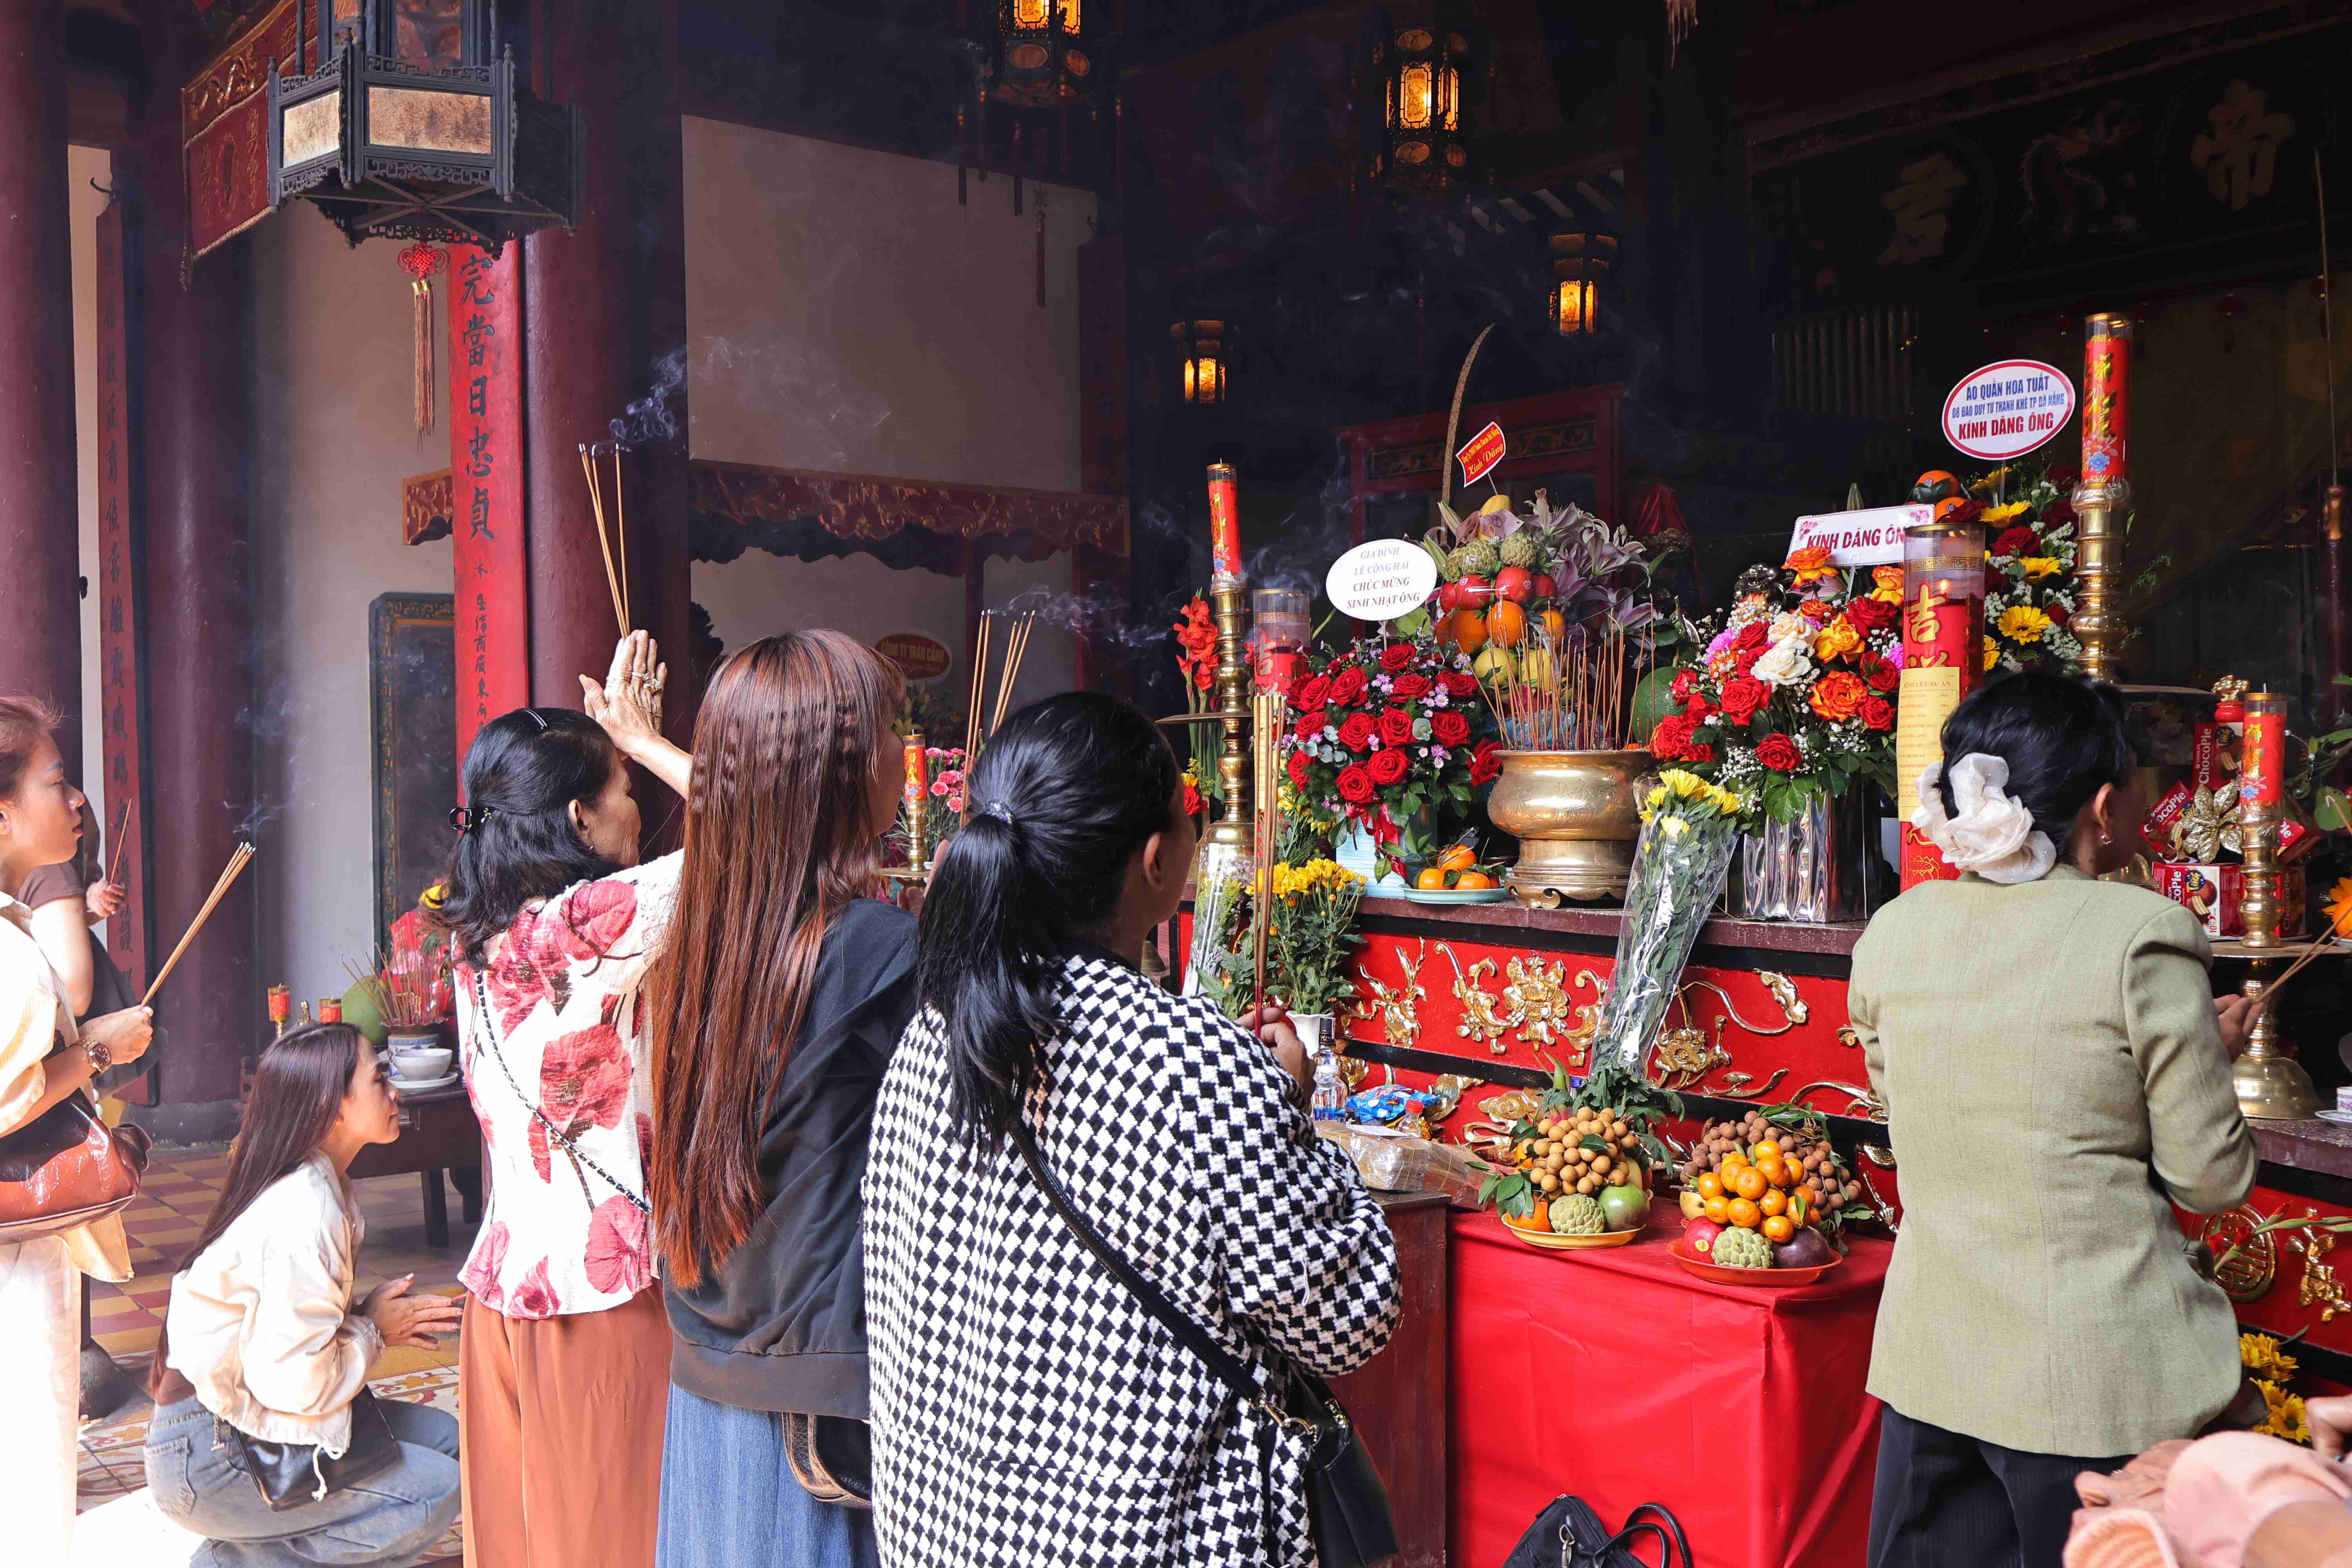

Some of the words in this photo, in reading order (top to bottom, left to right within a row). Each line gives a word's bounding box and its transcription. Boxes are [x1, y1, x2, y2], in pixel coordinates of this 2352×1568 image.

[1966, 384, 1977, 401] ÁO
[2005, 379, 2024, 395] HOA
[2027, 371, 2050, 392] TUẤT
[1952, 407, 1960, 419] 08
[1975, 404, 1986, 416] DUY
[1995, 401, 2014, 413] THANH
[2016, 397, 2028, 410] KHÊ
[2029, 397, 2037, 408] TP
[1958, 420, 1987, 440] KÍNH
[1991, 416, 2024, 436] DÂNG
[2028, 411, 2054, 432] ÔNG
[1806, 531, 1839, 549] KÍNH
[1842, 527, 1881, 549] DÂNG
[1885, 524, 1905, 544] ÔN
[1360, 550, 1375, 559] GIA
[1354, 564, 1365, 575] LÊ
[1353, 579, 1379, 592] CHÚC
[1381, 576, 1410, 589] MỪNG
[1347, 598, 1369, 609] SINH
[1371, 595, 1397, 607] NHẬT
[1399, 592, 1420, 604] ÔNG
[2154, 797, 2170, 813] ORION
